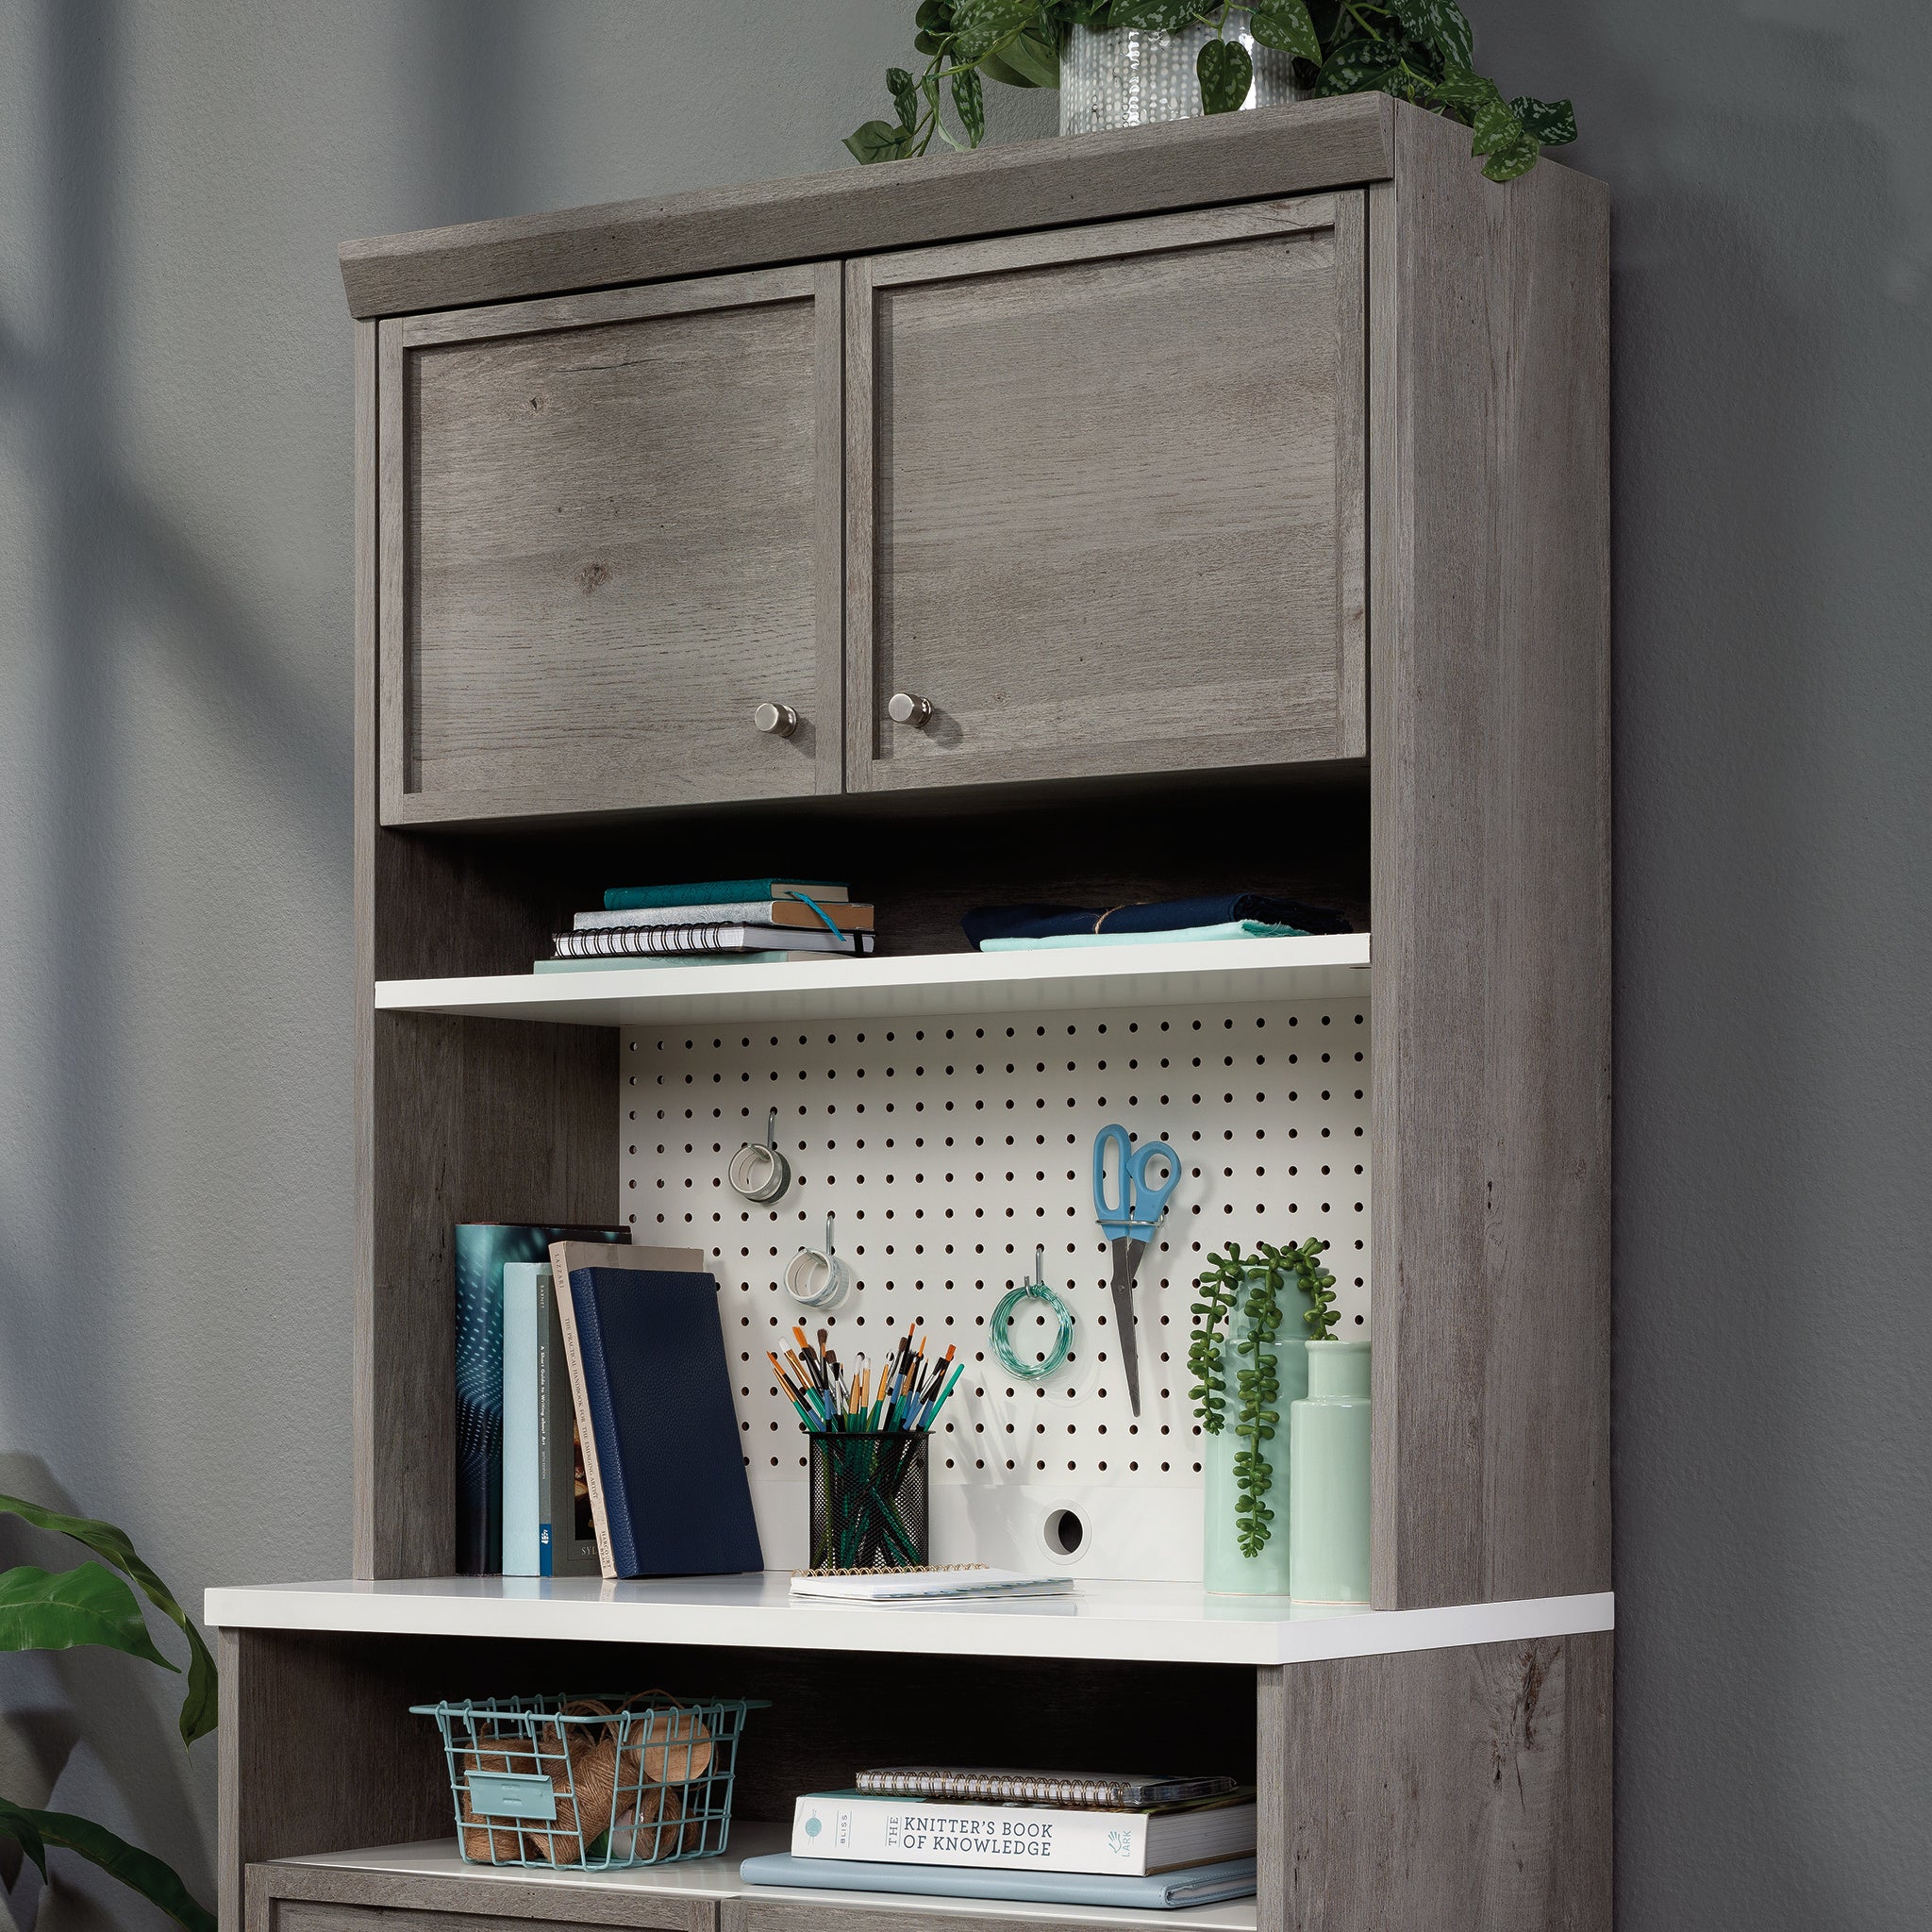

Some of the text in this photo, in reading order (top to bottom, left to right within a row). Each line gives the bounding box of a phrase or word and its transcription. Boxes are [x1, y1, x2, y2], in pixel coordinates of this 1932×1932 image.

[555, 1253, 565, 1288] LAZZARI
[567, 1332, 576, 1368] PRACTICAL
[574, 1369, 583, 1407] HANDBOOK
[590, 1477, 598, 1499] ARTIST
[601, 1531, 611, 1569] HARCOURT
[839, 1814, 848, 1844] BLISS
[888, 1816, 898, 1846] THE
[904, 1817, 1053, 1838] KNITTER'S BOOK
[903, 1835, 1052, 1857] OF KNOWLEDGE
[1122, 1830, 1131, 1857] LARK
